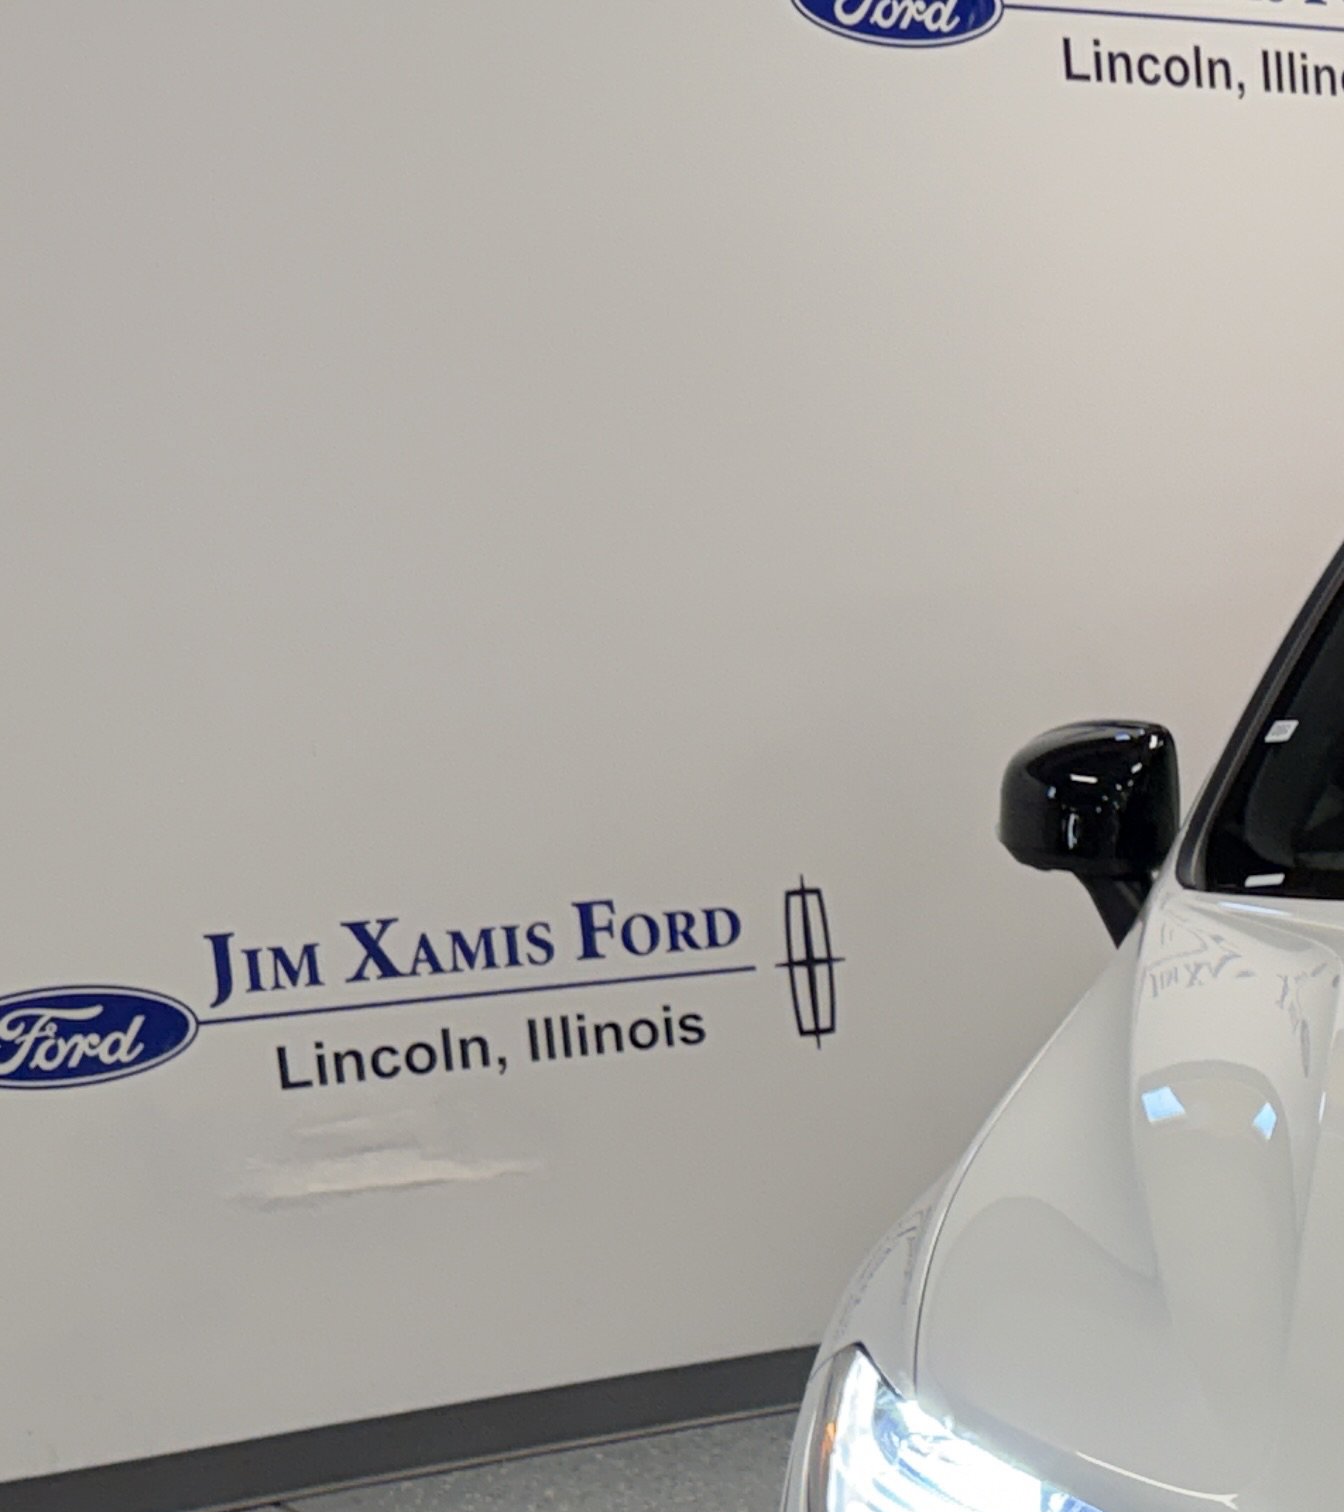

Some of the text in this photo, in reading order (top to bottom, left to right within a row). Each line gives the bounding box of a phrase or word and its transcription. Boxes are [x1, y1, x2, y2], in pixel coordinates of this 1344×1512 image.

[1062, 37, 1246, 99] Lincoln,
[0, 1004, 146, 1075] Ford
[275, 1005, 706, 1091] Lincoln, Illinois
